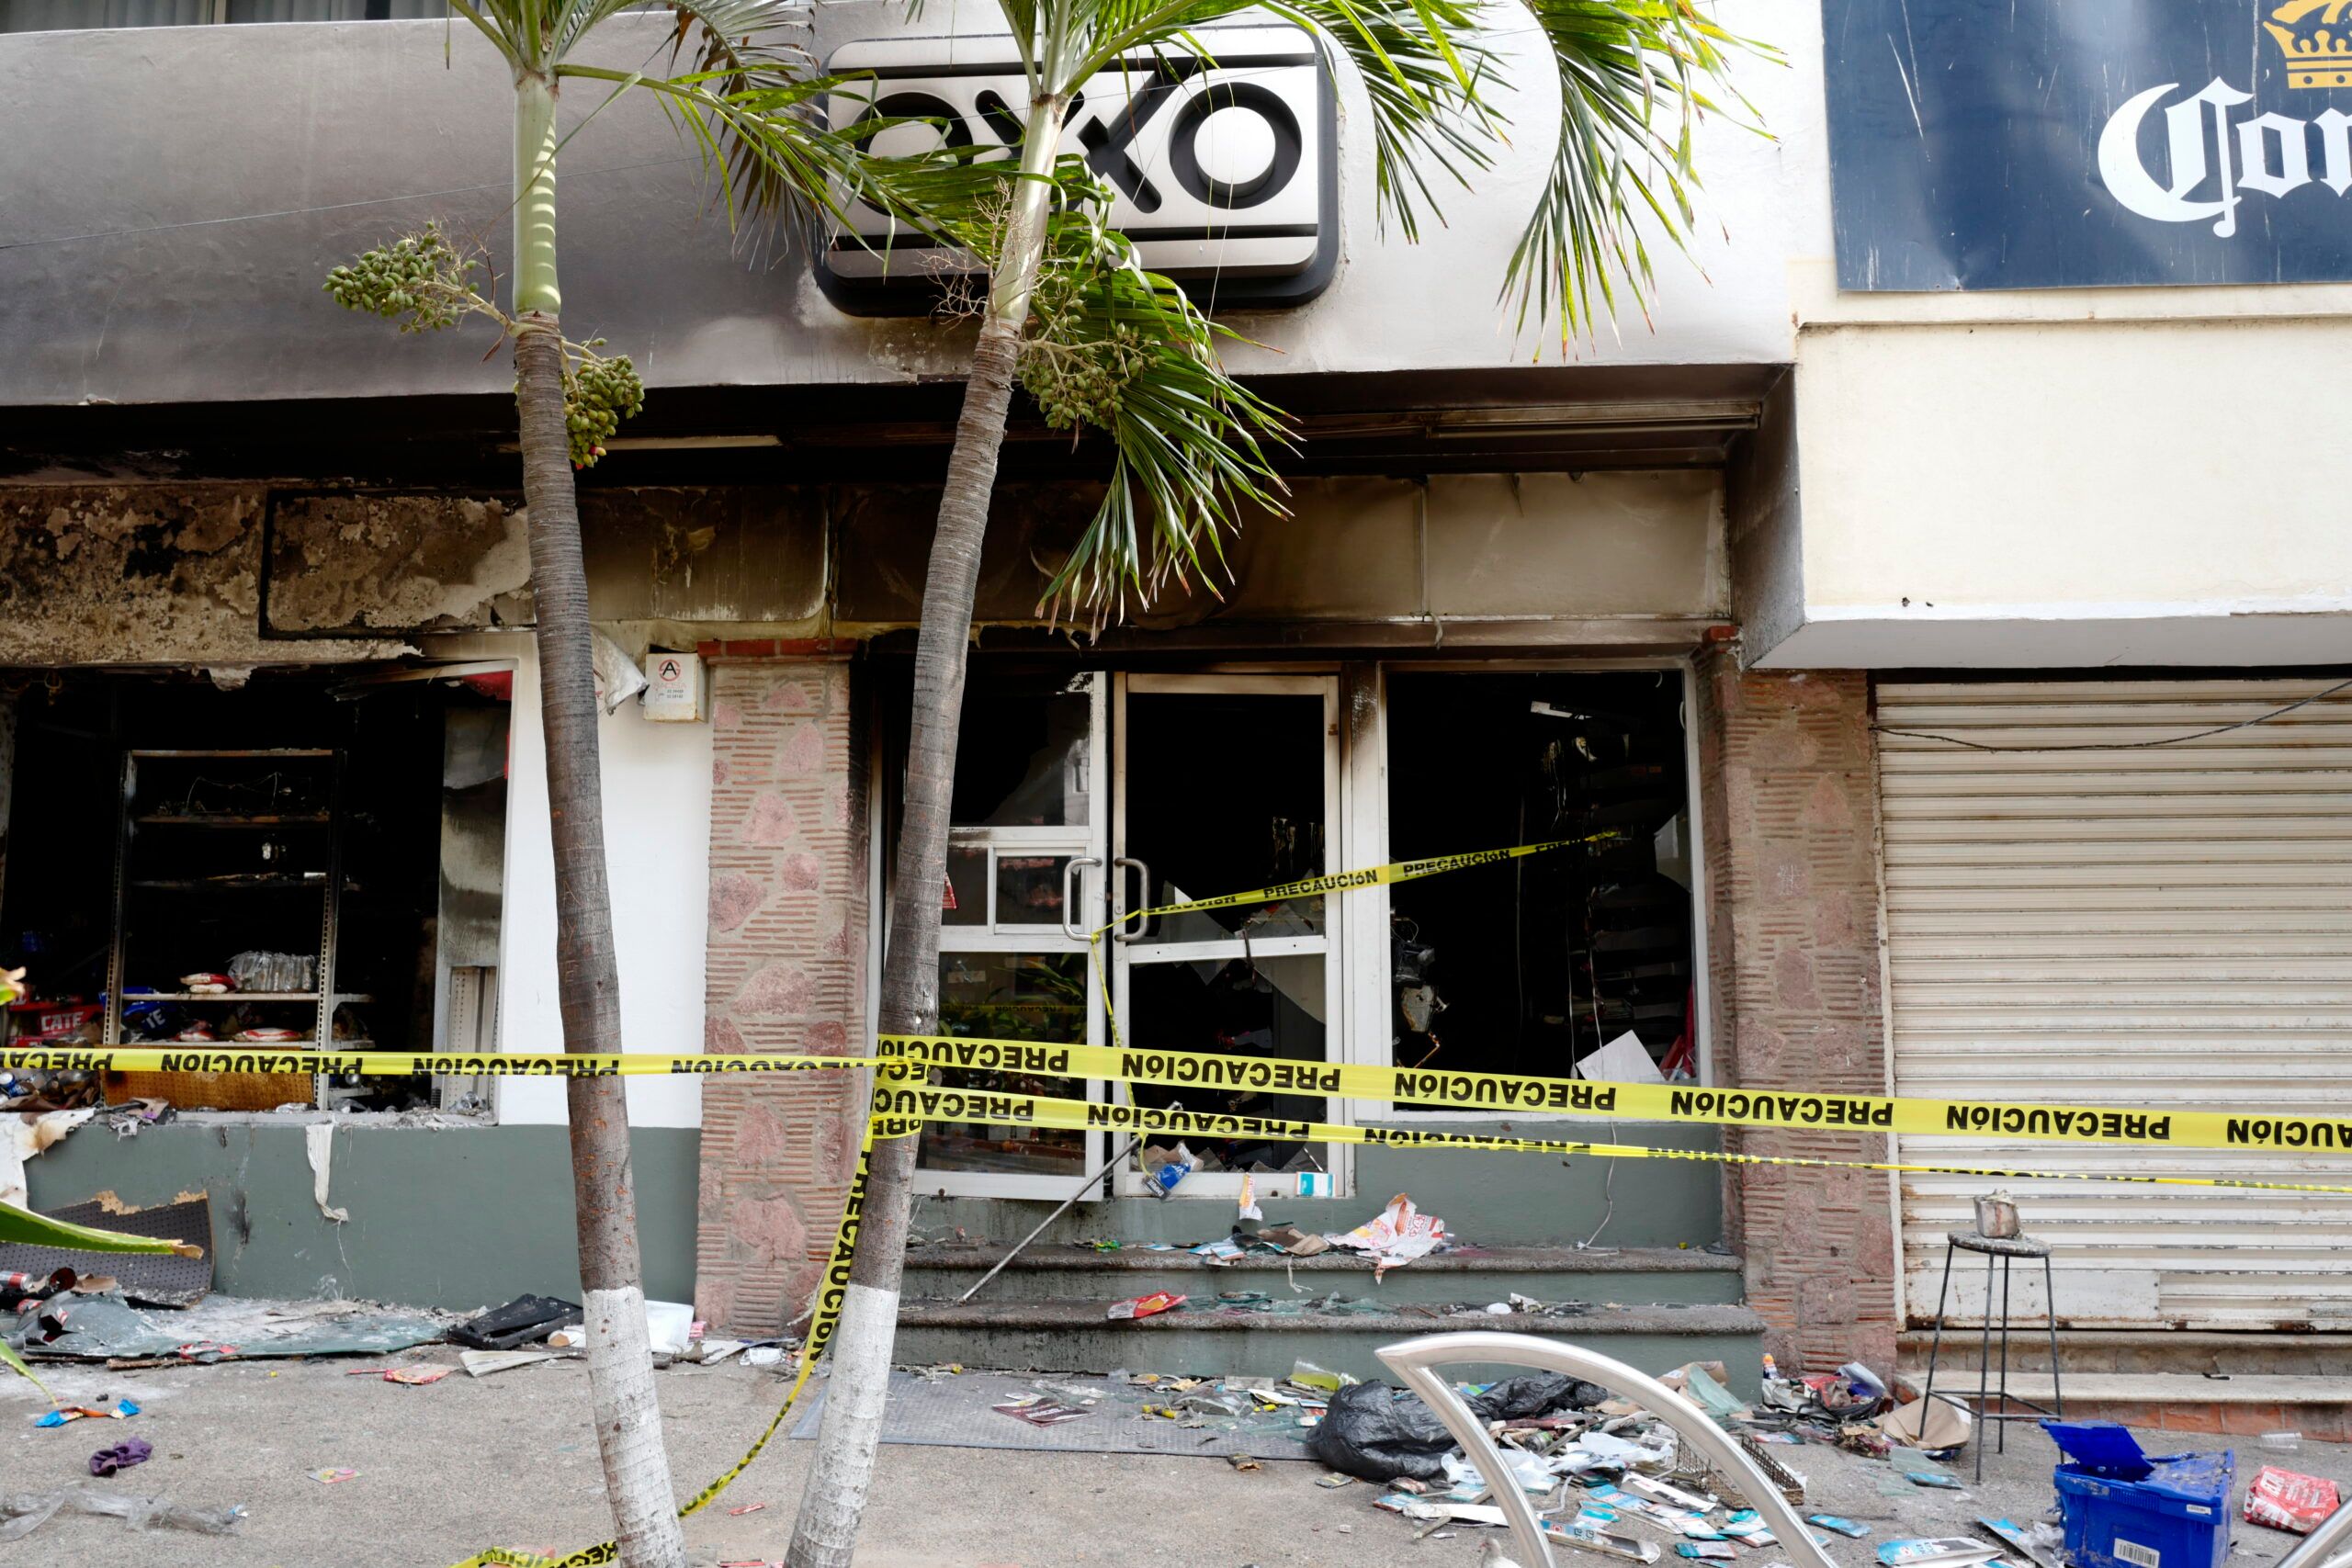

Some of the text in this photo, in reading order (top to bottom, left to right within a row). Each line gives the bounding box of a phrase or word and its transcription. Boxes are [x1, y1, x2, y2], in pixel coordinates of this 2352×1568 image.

[1122, 1053, 1341, 1092] PRECAUCIÓN
[1395, 1072, 1617, 1111] PRECAUCIÓN
[1670, 1090, 1894, 1127] PRECAUCIÓN
[1946, 1105, 2172, 1140] PRECAUCIÓN
